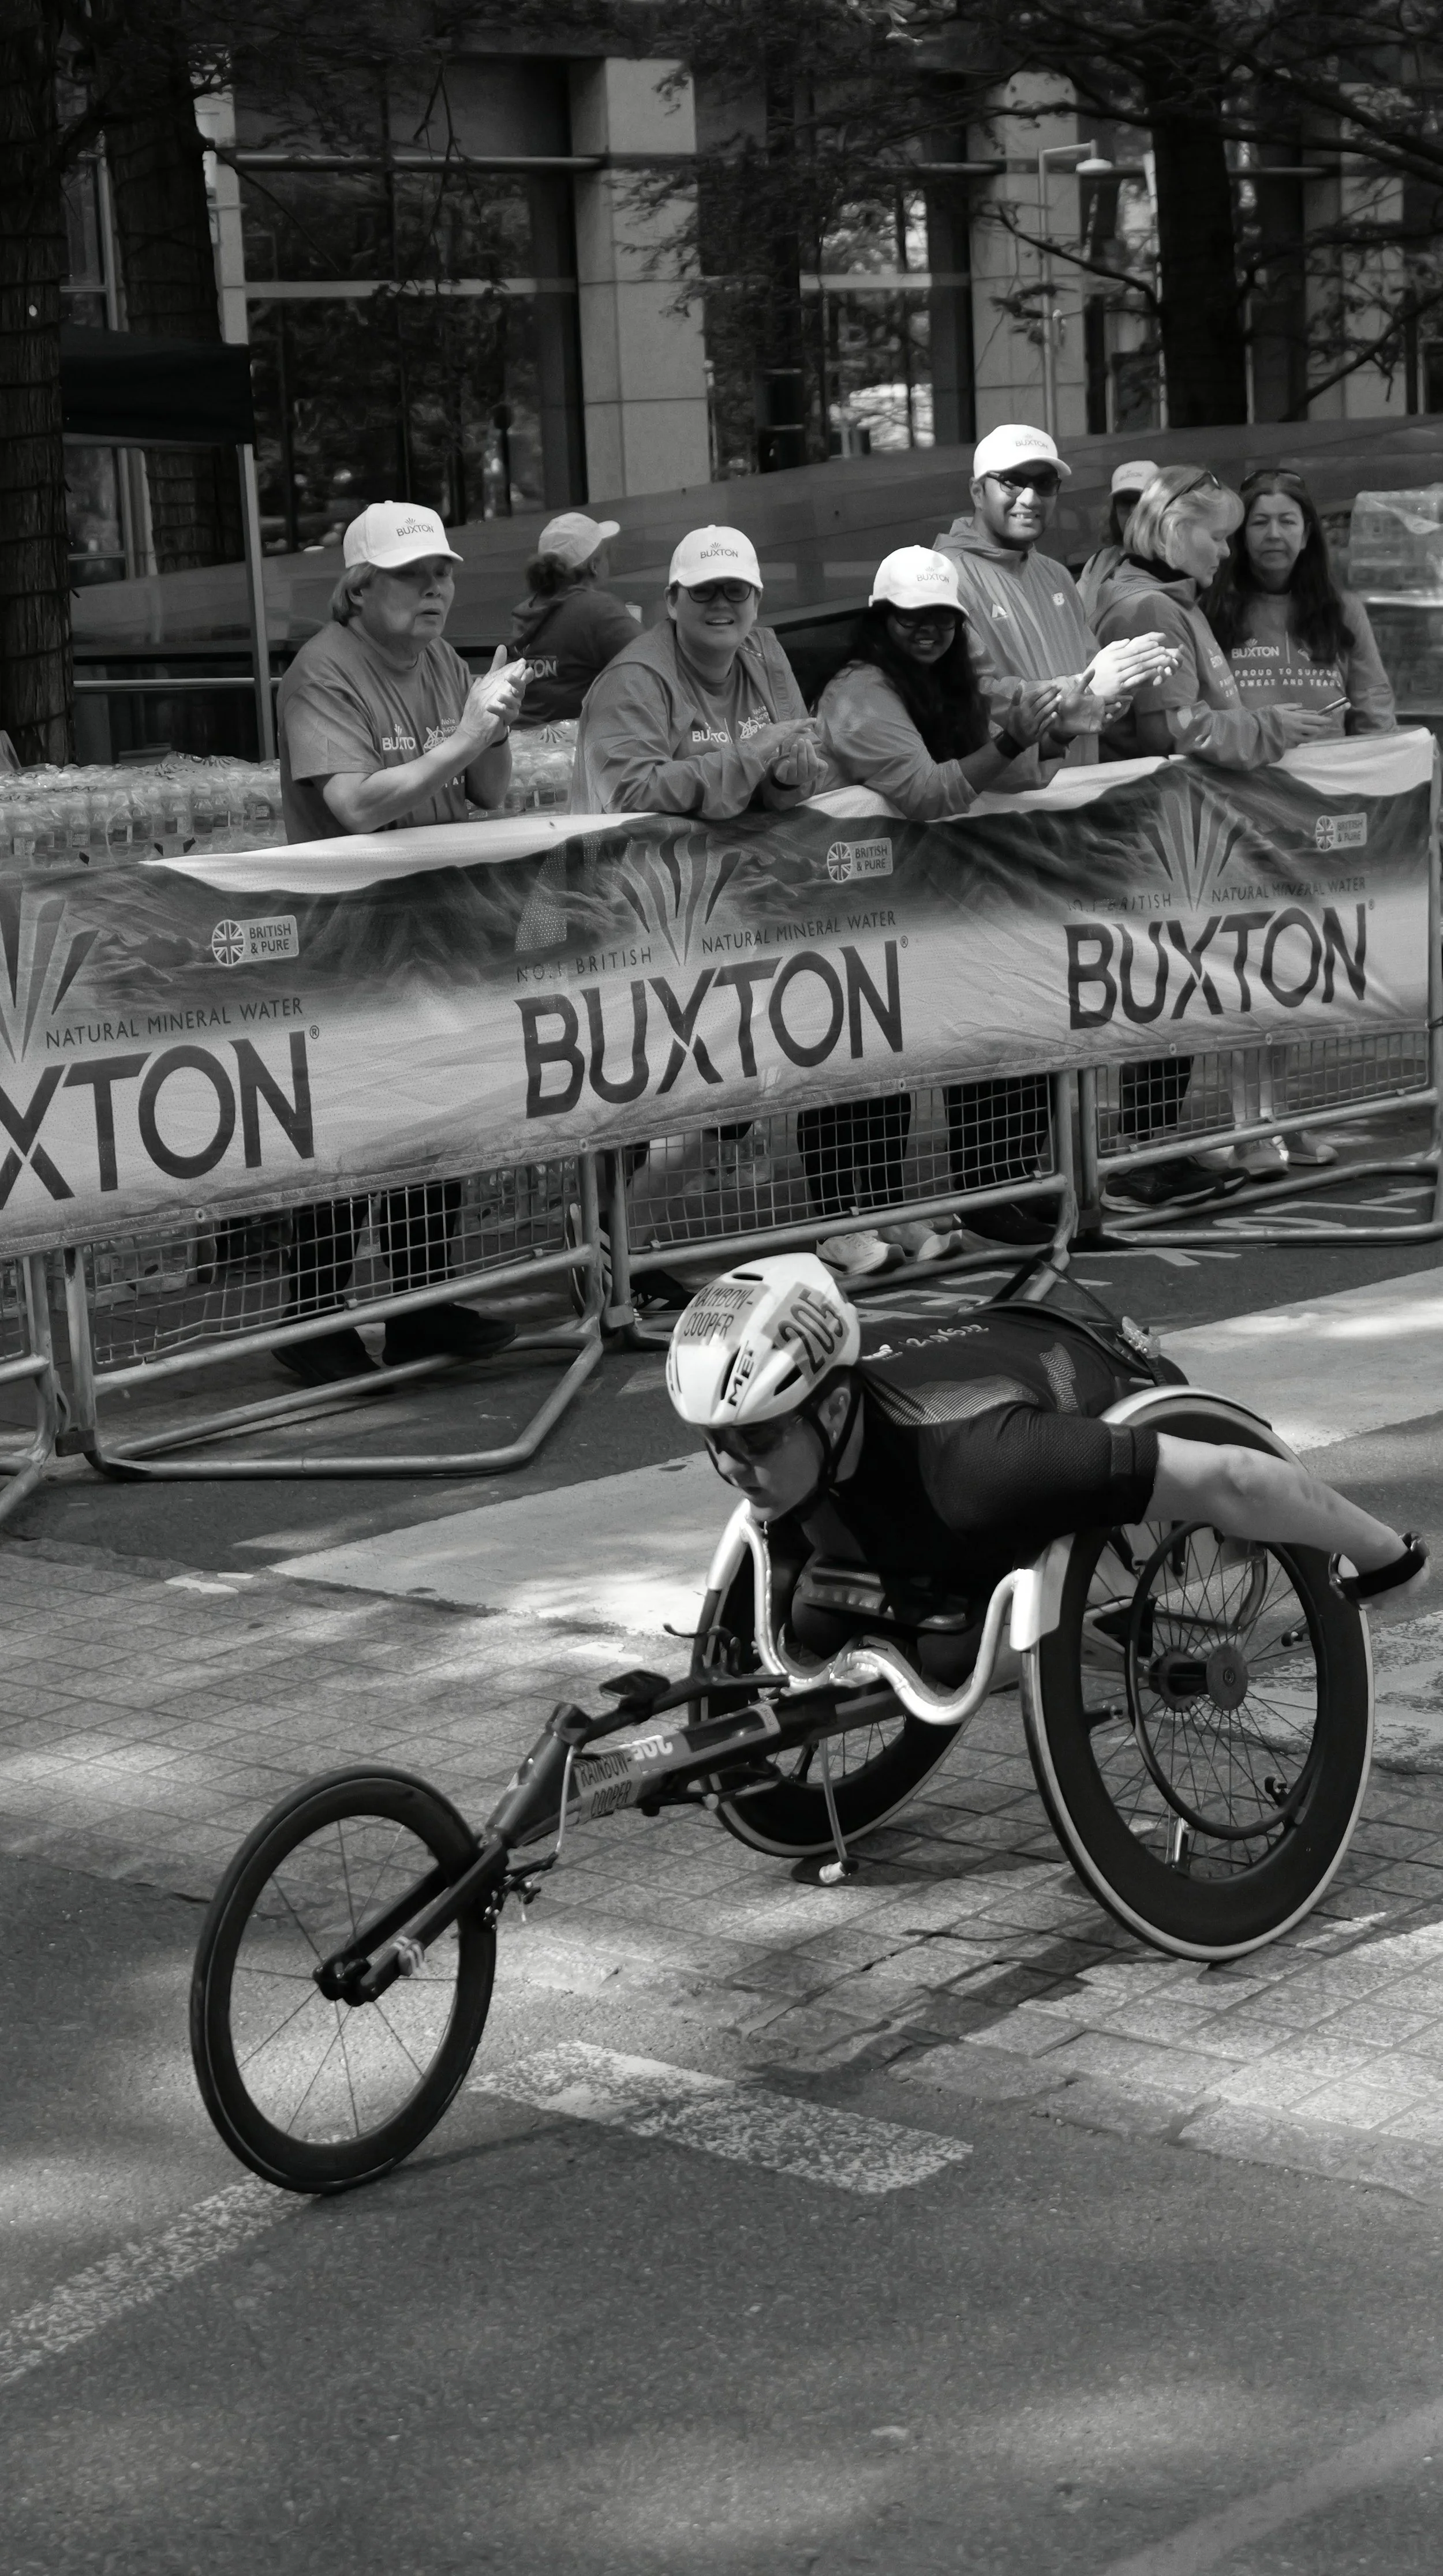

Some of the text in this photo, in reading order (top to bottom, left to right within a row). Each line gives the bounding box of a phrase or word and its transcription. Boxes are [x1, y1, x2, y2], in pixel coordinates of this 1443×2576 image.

[1015, 439, 1049, 450] BUXTON
[396, 525, 434, 537] BUXTON
[700, 548, 738, 559] BUXTON
[917, 573, 949, 583] BUXTON
[1231, 646, 1279, 658] BUXTON
[1235, 669, 1272, 677] PROUD
[854, 845, 888, 859] BRITISH
[857, 856, 887, 871] & PURE
[1212, 886, 1269, 903] NATURAL
[1328, 877, 1366, 893] WATER
[249, 923, 292, 939] BRITISH
[250, 938, 290, 953] & PURE
[577, 947, 652, 975] BRITISH
[701, 927, 771, 954] NATURAL
[775, 919, 841, 942] MINERAL
[846, 910, 896, 928] WATER
[1063, 903, 1366, 1030] BUXTON
[45, 997, 304, 1049] NATURAL MINERAL WATER
[514, 940, 903, 1119] BUXTON
[777, 1287, 843, 1375] 205
